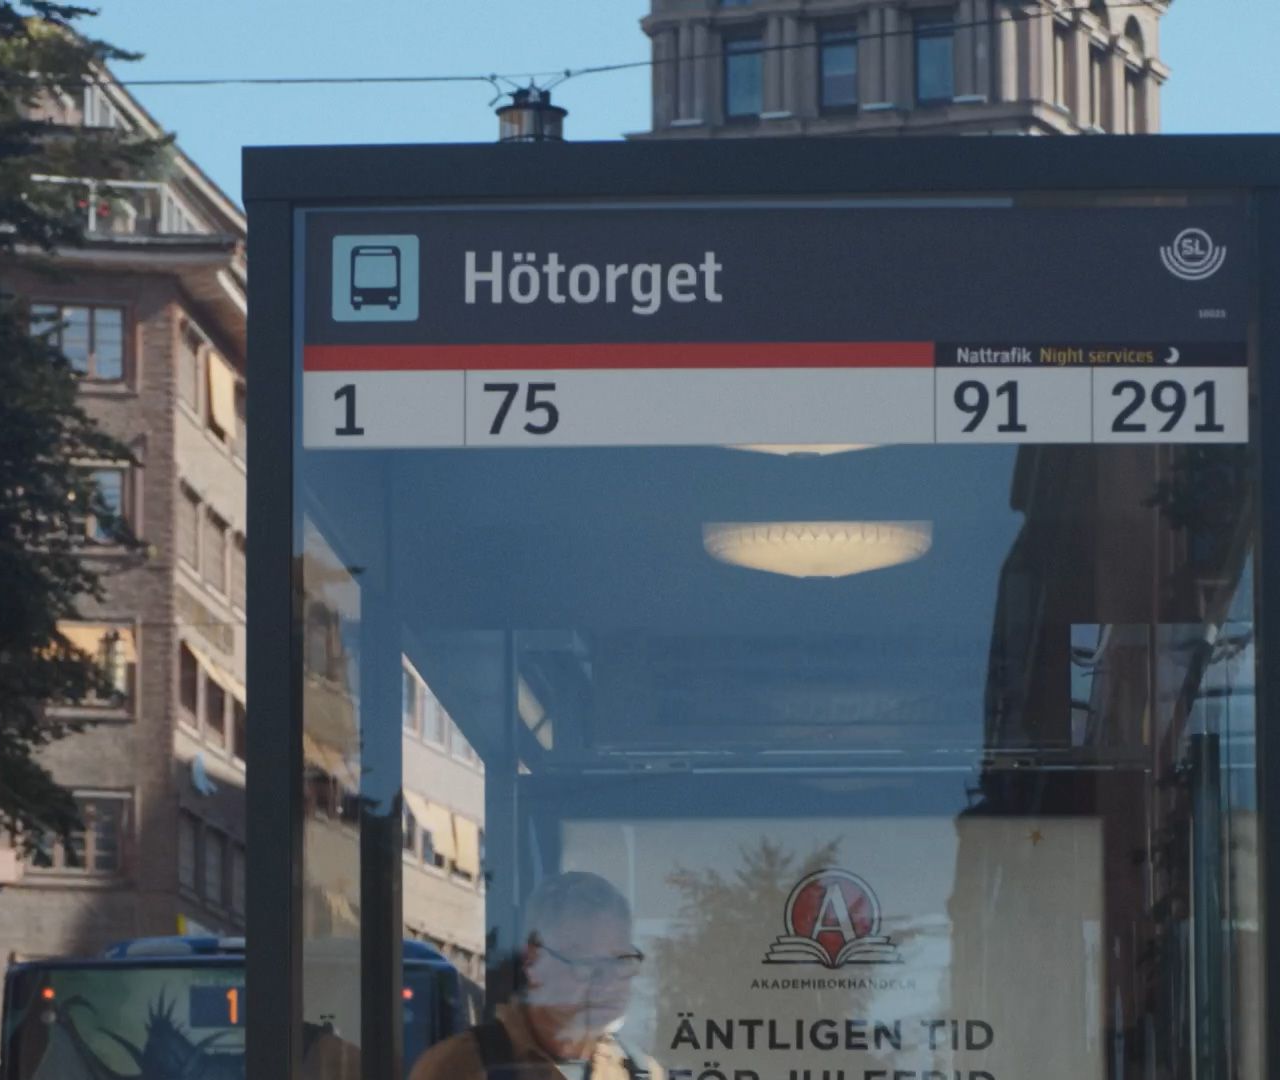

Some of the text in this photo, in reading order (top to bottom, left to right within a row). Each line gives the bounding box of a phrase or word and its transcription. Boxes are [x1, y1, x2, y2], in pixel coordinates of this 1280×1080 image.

[1181, 237, 1206, 257] SL
[464, 250, 723, 314] Hötorget
[956, 347, 1154, 366] Nattrafik Night services
[334, 386, 364, 436] 1
[483, 384, 560, 436] 75
[953, 379, 1027, 432] 91
[1111, 379, 1225, 432] 291
[810, 883, 854, 942] A
[671, 1012, 994, 1051] ÄNTLIGEN TID
